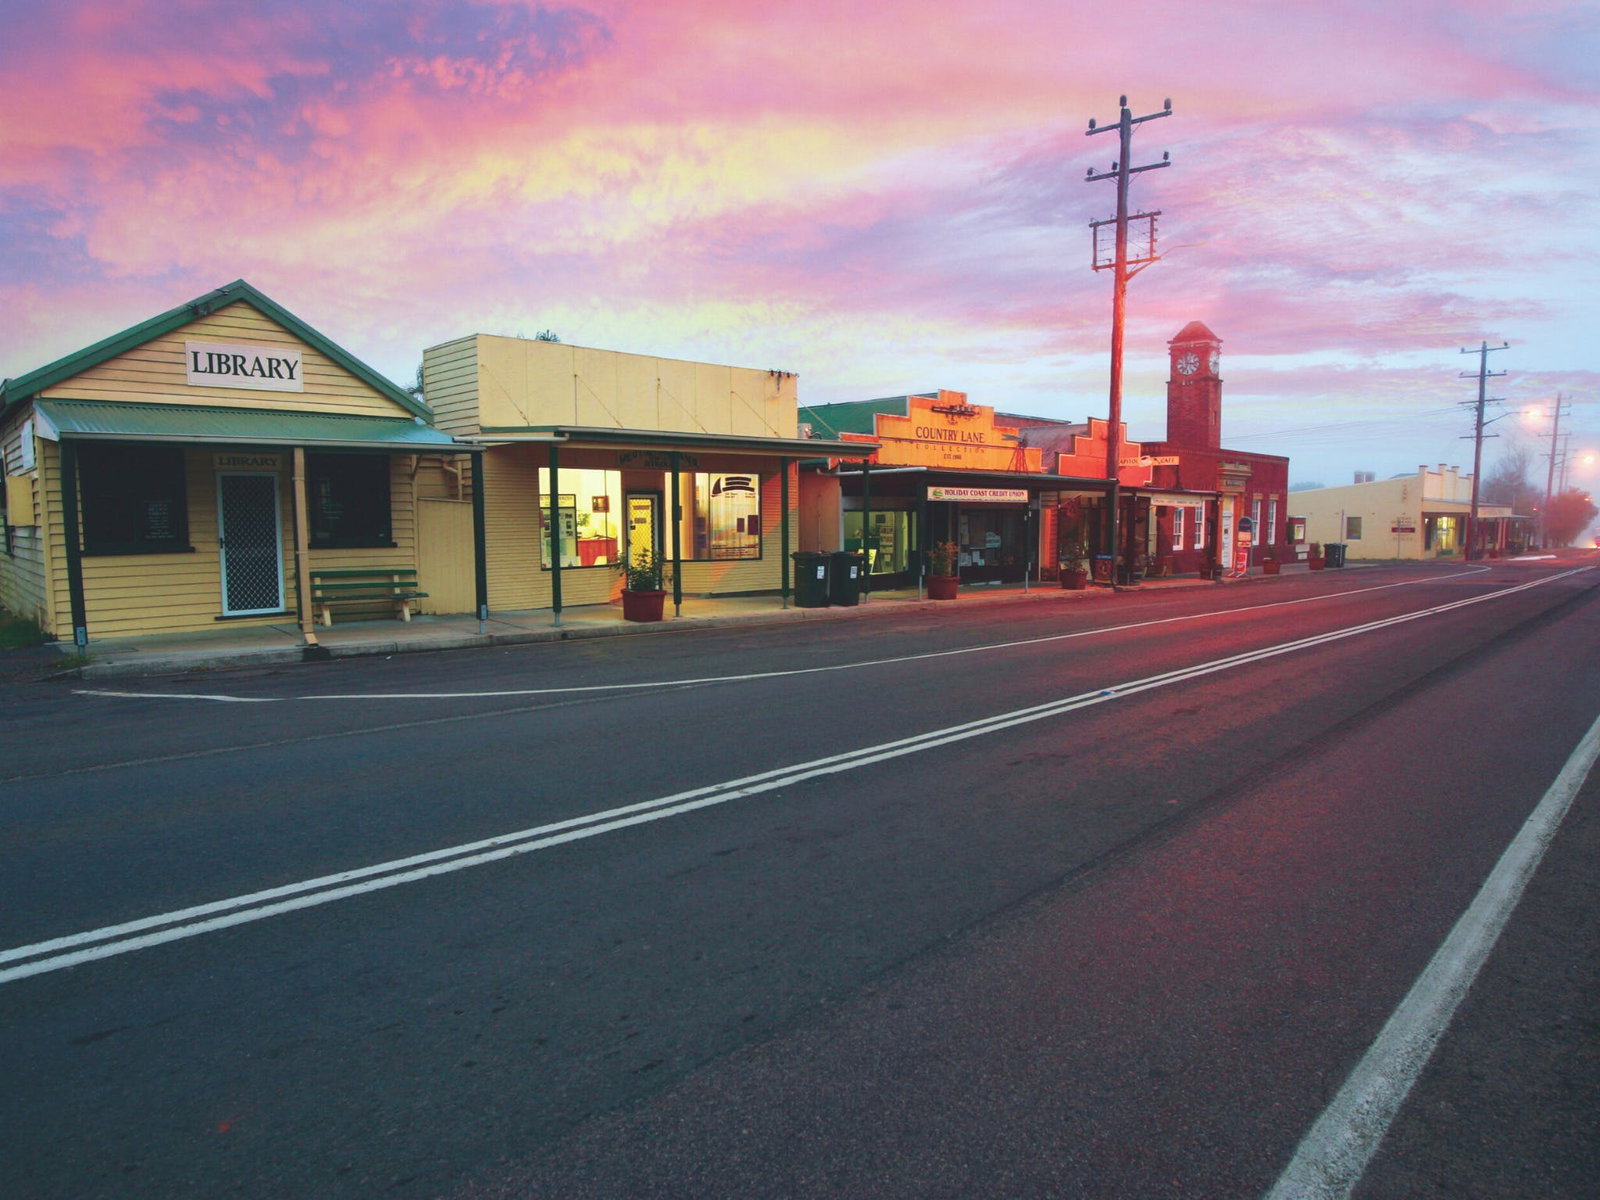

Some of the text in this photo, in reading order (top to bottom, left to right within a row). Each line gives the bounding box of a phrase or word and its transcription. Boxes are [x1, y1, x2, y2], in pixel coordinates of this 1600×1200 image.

[191, 350, 299, 380] LIBRARY
[915, 426, 985, 443] COUNTRY LANE
[915, 444, 986, 453] COLLECTION
[217, 455, 278, 466] LIBRARY
